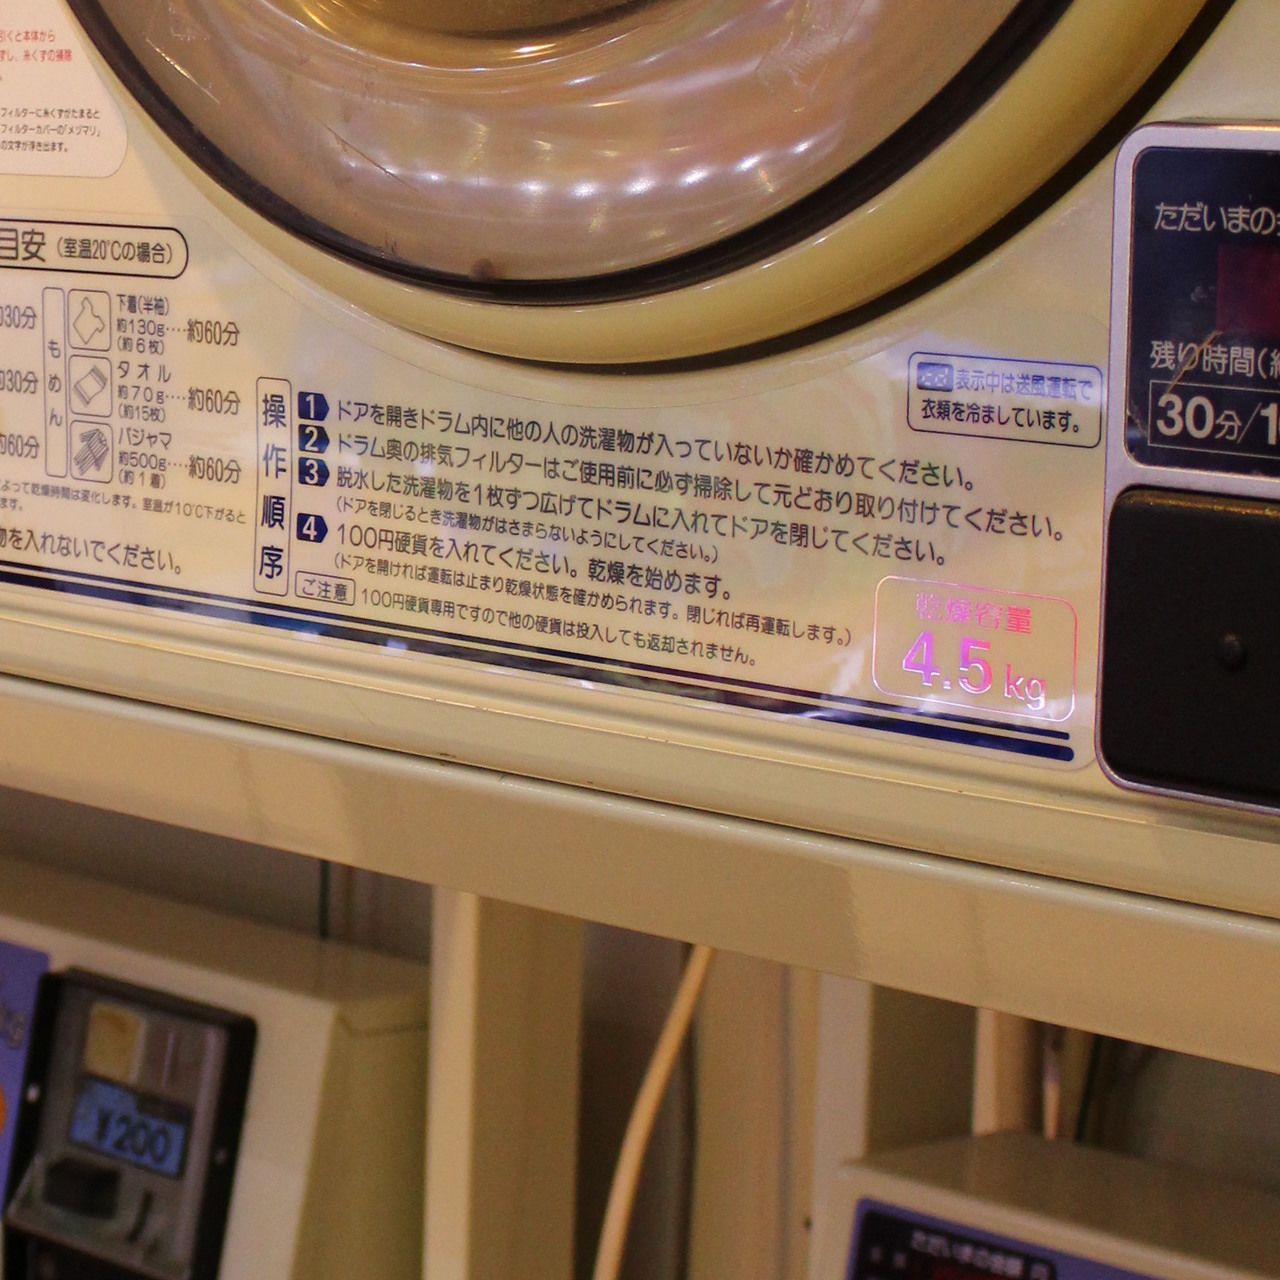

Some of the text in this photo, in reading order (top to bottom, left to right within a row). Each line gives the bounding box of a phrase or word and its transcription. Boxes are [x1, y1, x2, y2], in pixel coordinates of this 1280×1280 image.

[1154, 201, 1280, 238] ただいまの
[117, 318, 241, 347] 約130g 約60分
[48, 338, 63, 427] もめん
[117, 360, 172, 383] タオル
[955, 368, 1094, 401] 表示中は送風運転で
[188, 386, 241, 415] 約60分
[921, 397, 1080, 433] 衣類を冷ましています。
[1156, 392, 1280, 446] 30分/1
[337, 399, 974, 491] ドアを開きドラム内に他の人の洗濯物が入っていないか確かめてください。
[188, 454, 242, 484] 約60分
[259, 393, 287, 580] 操作順序
[304, 426, 1064, 542] 2 ドラム奥の排気フィルターはご使用前に必ず掃除して元どおり取り付けてください。
[301, 515, 317, 542] 4
[304, 458, 946, 566] 3 脱水した洗濯物を1枚ずつ広げてドラムに入れてドアを閉じてください。
[301, 576, 757, 667] ご注意 100円硬貨専用ですので他の硬貨は投入しても返却されません。
[915, 591, 1033, 635] 乾燥容量
